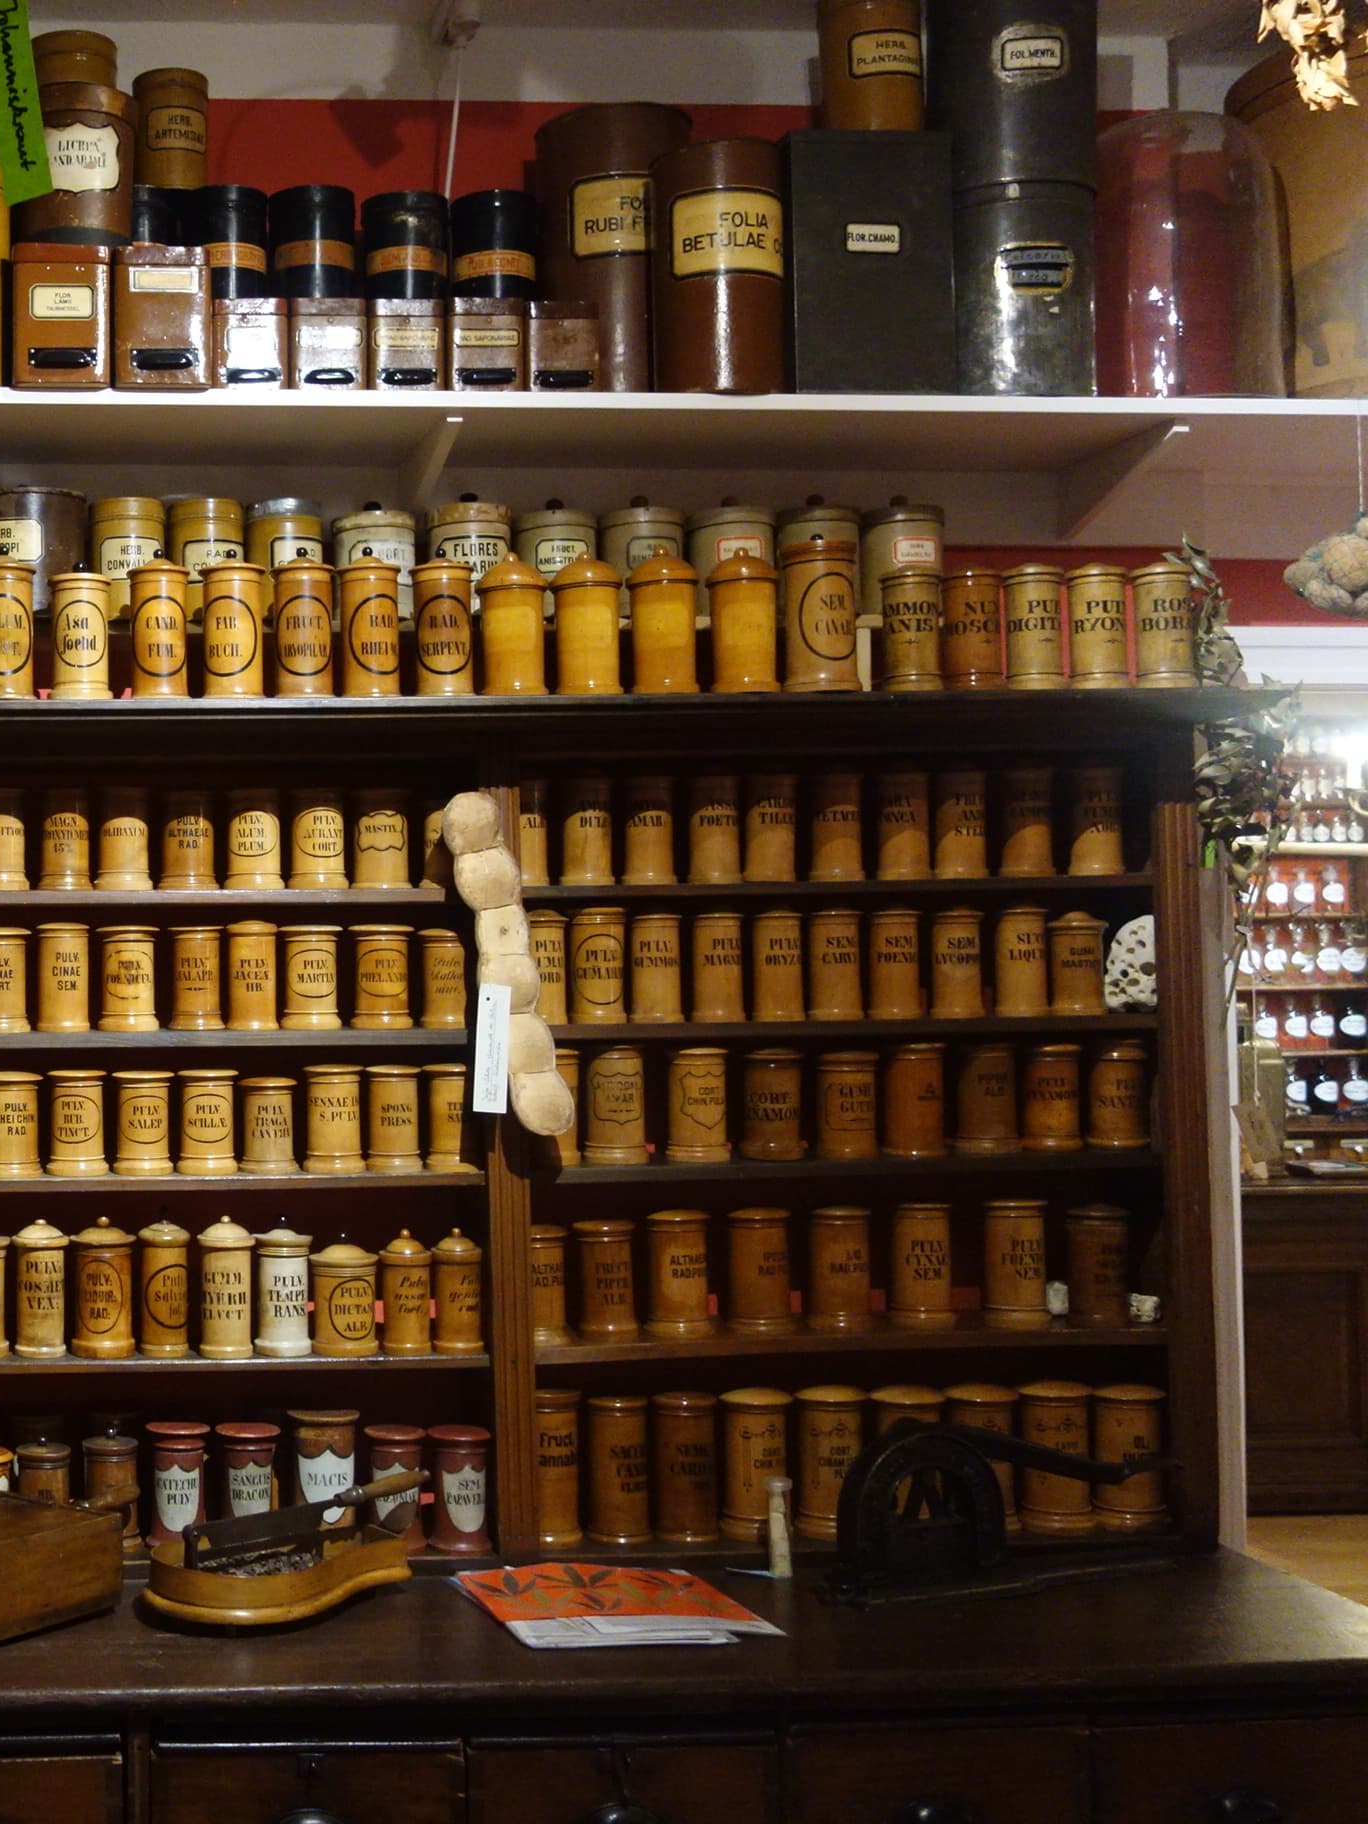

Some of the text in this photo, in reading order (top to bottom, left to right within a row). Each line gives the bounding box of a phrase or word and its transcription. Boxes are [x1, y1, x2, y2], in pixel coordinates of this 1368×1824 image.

[620, 197, 646, 212] FO
[584, 215, 624, 235] RUBI
[719, 210, 768, 230] FOLIA
[681, 231, 765, 254] BETULAE
[454, 543, 498, 557] FLORES
[64, 614, 89, 628] Asa
[52, 966, 81, 976] CINAE
[308, 1473, 348, 1485] MACIS
